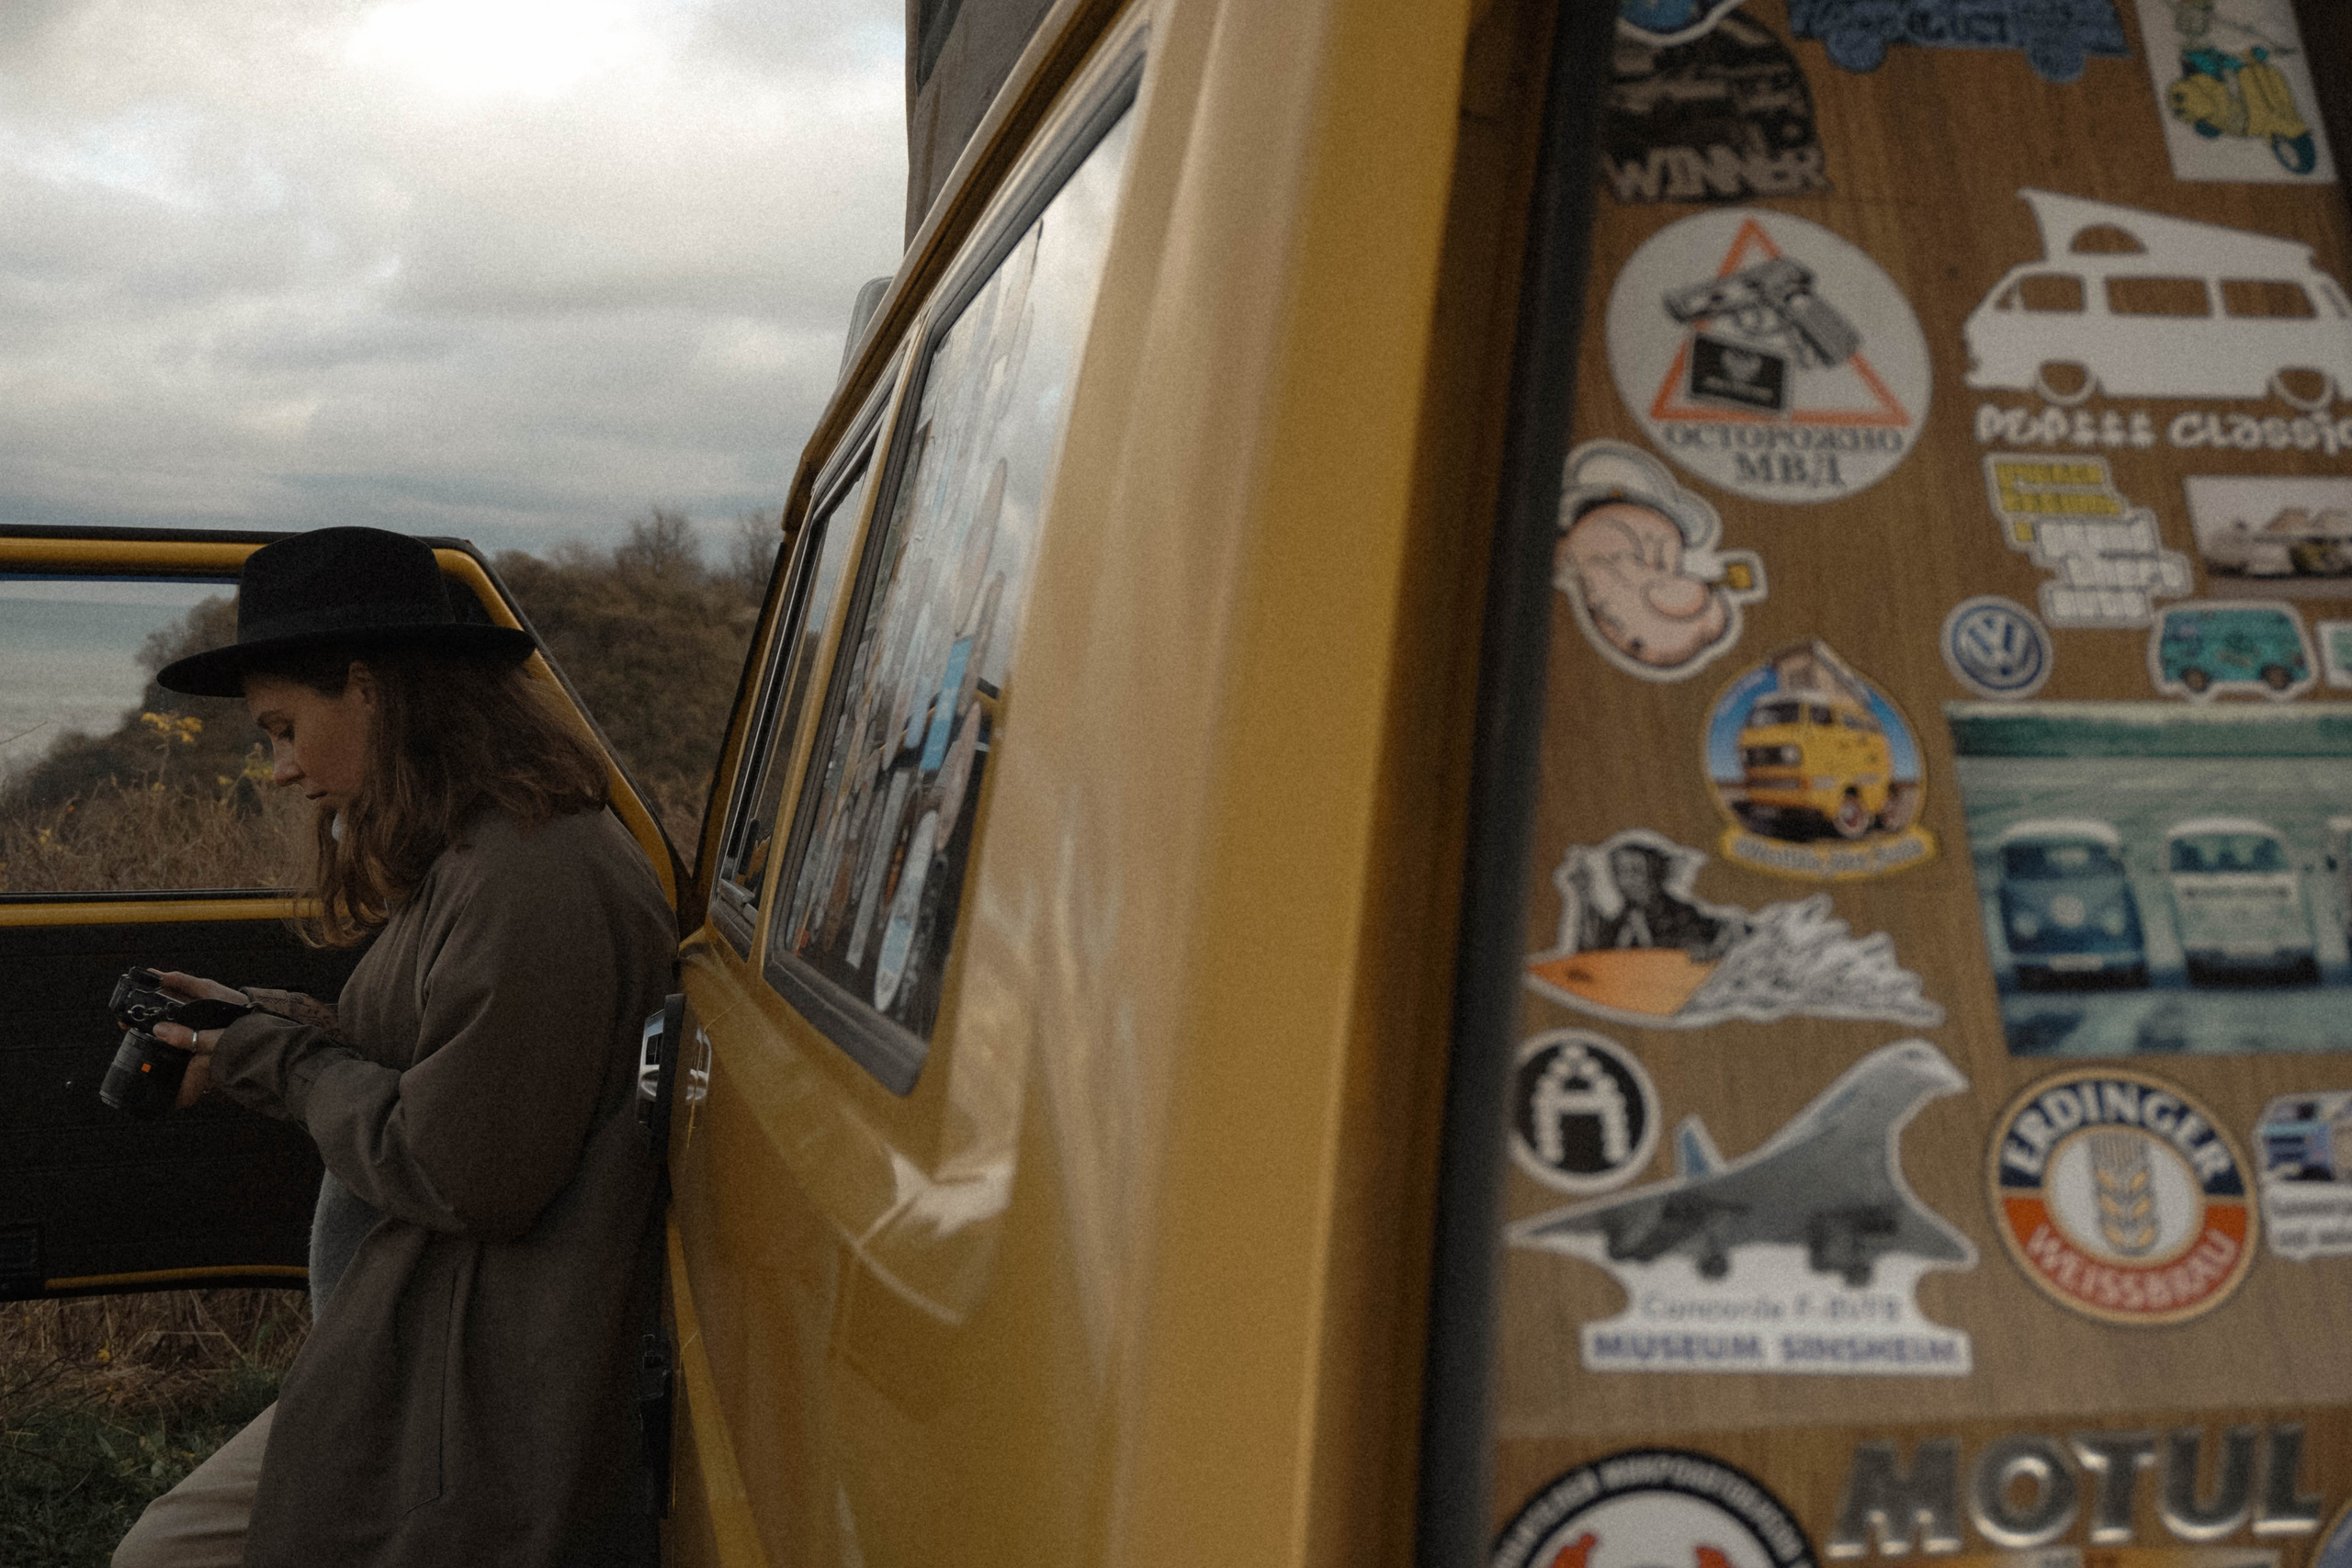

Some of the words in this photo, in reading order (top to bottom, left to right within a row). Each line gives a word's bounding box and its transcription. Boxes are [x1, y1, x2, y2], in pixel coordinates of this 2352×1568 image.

[1604, 144, 1834, 197] WINNER
[2005, 1080, 2230, 1181] ERDINGER
[1591, 1335, 1762, 1359] MUSEUM
[1826, 1423, 2324, 1558] MOTUL
